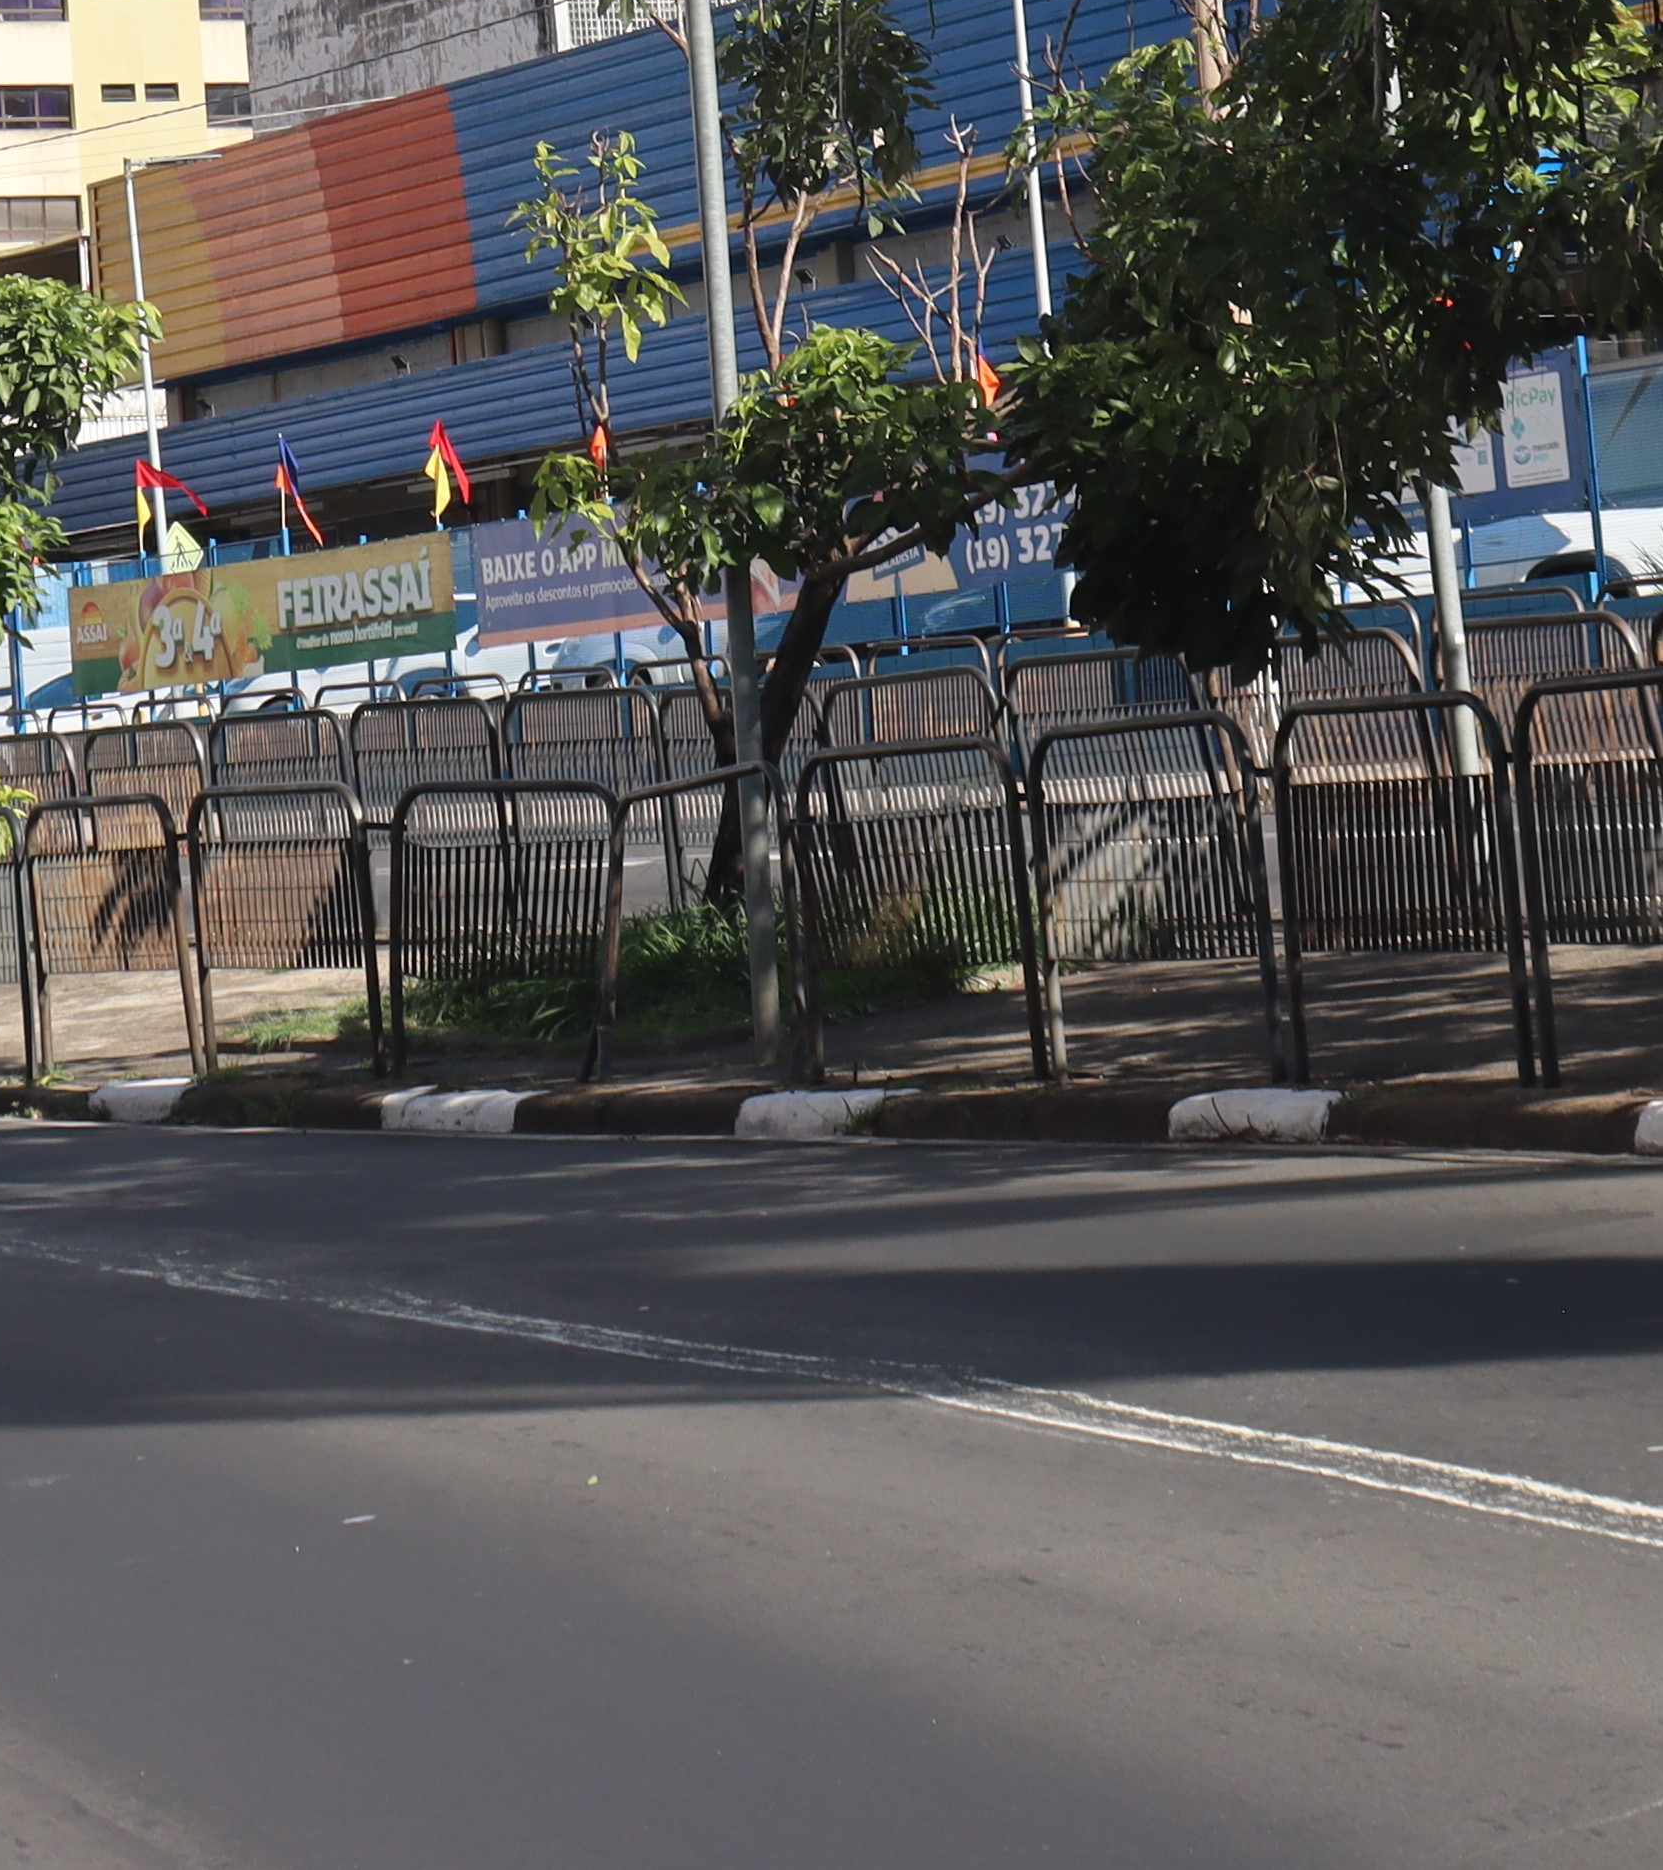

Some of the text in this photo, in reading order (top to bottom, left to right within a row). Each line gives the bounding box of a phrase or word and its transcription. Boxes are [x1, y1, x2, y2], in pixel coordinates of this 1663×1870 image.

[480, 550, 537, 586] BAIXE
[541, 548, 555, 577] O
[559, 542, 597, 575] APP
[965, 533, 1010, 575] (19)
[276, 546, 433, 630] FEIRASSAÍ
[485, 589, 525, 613] Aproveite
[525, 590, 536, 604] os
[537, 585, 582, 603] descontos
[583, 584, 589, 597] e
[589, 576, 638, 600] promoções
